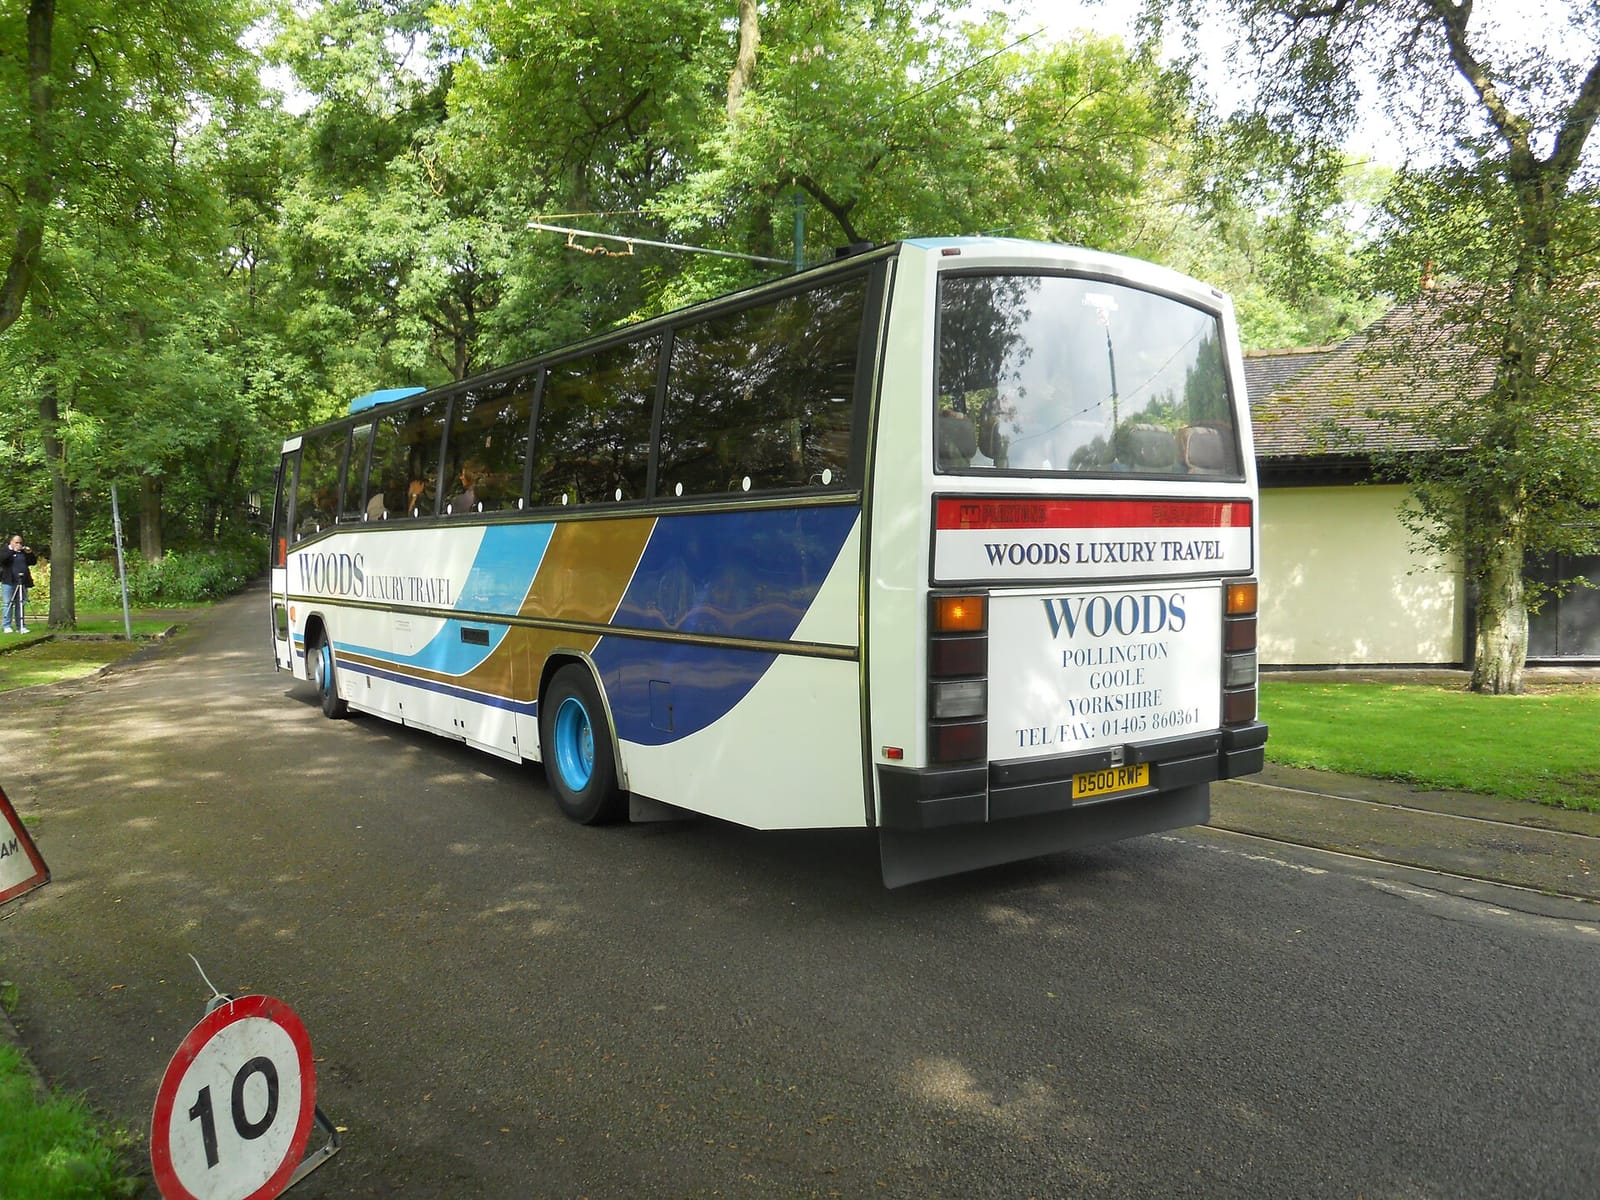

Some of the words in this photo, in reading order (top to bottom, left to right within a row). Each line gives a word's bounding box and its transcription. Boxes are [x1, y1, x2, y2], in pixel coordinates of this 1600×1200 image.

[984, 542, 1070, 566] WOODS
[1076, 541, 1157, 564] LUXURY
[1161, 540, 1224, 562] TRAVEL
[299, 552, 364, 598] WOODS
[366, 575, 407, 600] LUXURY
[408, 576, 454, 606] TRAVEL
[1040, 593, 1186, 640] WOODS
[1062, 642, 1168, 668] POLLINGTON
[1089, 667, 1145, 690] GOOLE
[1068, 689, 1163, 717] YORKSHIRE
[1016, 722, 1095, 748] TEL/FAX:
[1102, 714, 1146, 737] 01405
[1152, 707, 1199, 730] 860361
[1118, 765, 1143, 787] RWF
[0, 838, 19, 859] AM
[189, 1056, 279, 1170] 10
